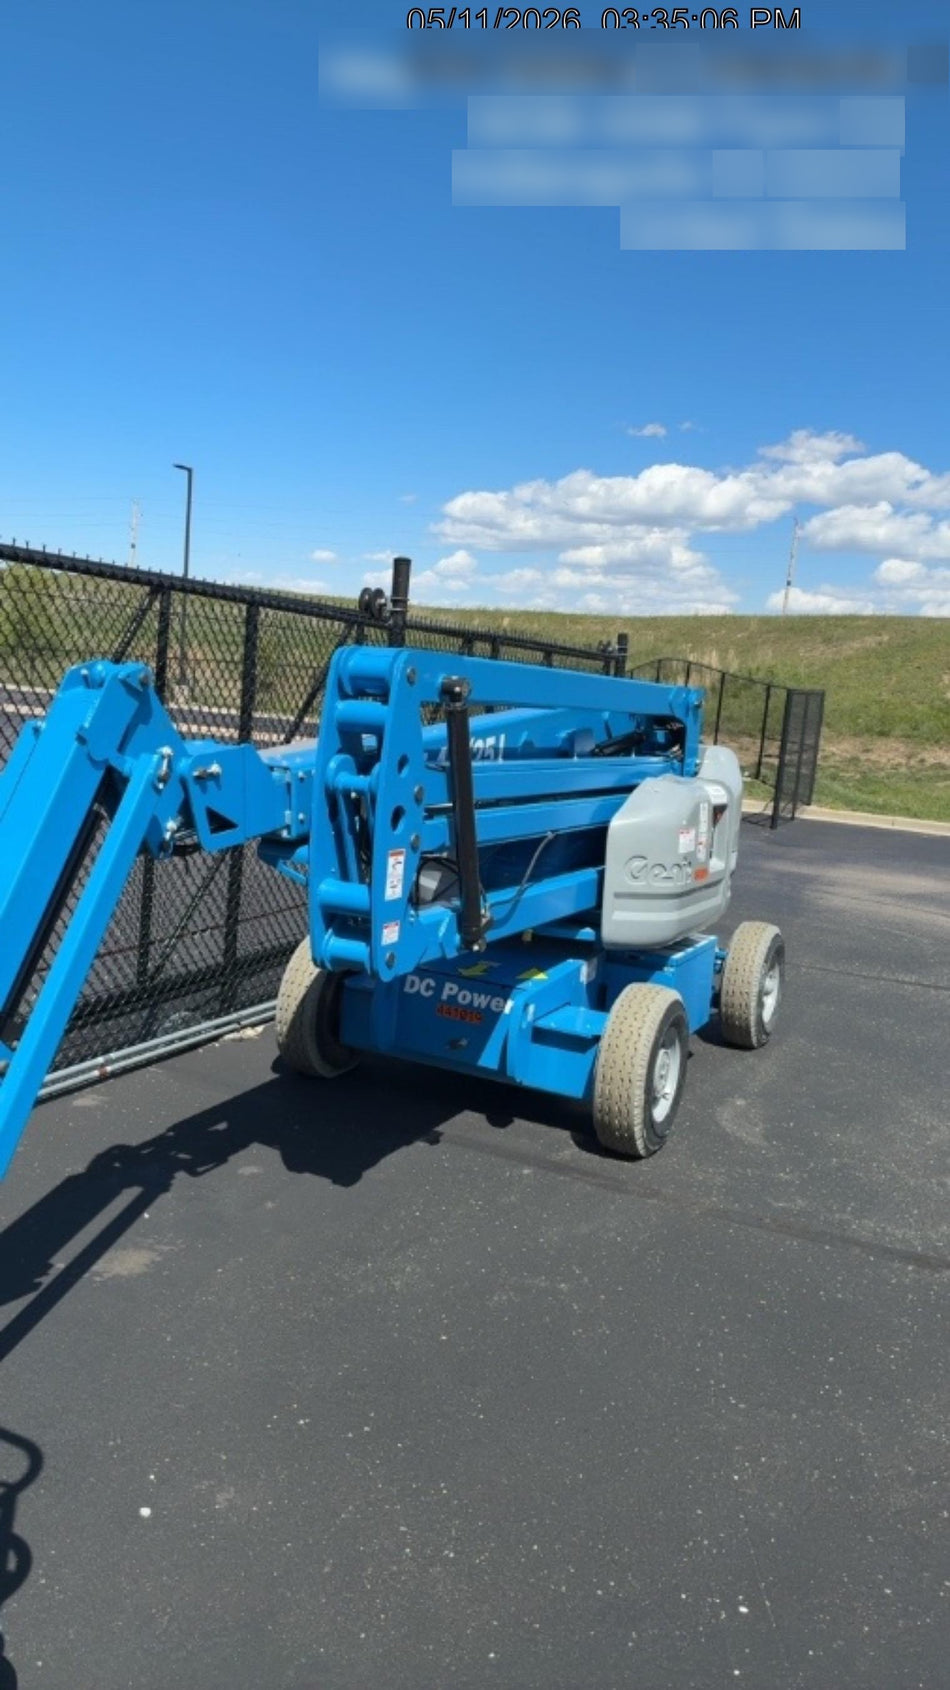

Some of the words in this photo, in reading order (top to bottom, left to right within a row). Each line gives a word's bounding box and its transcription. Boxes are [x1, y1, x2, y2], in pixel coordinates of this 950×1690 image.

[624, 855, 693, 885] Geni
[403, 974, 436, 998] DC
[441, 981, 515, 1015] Power
